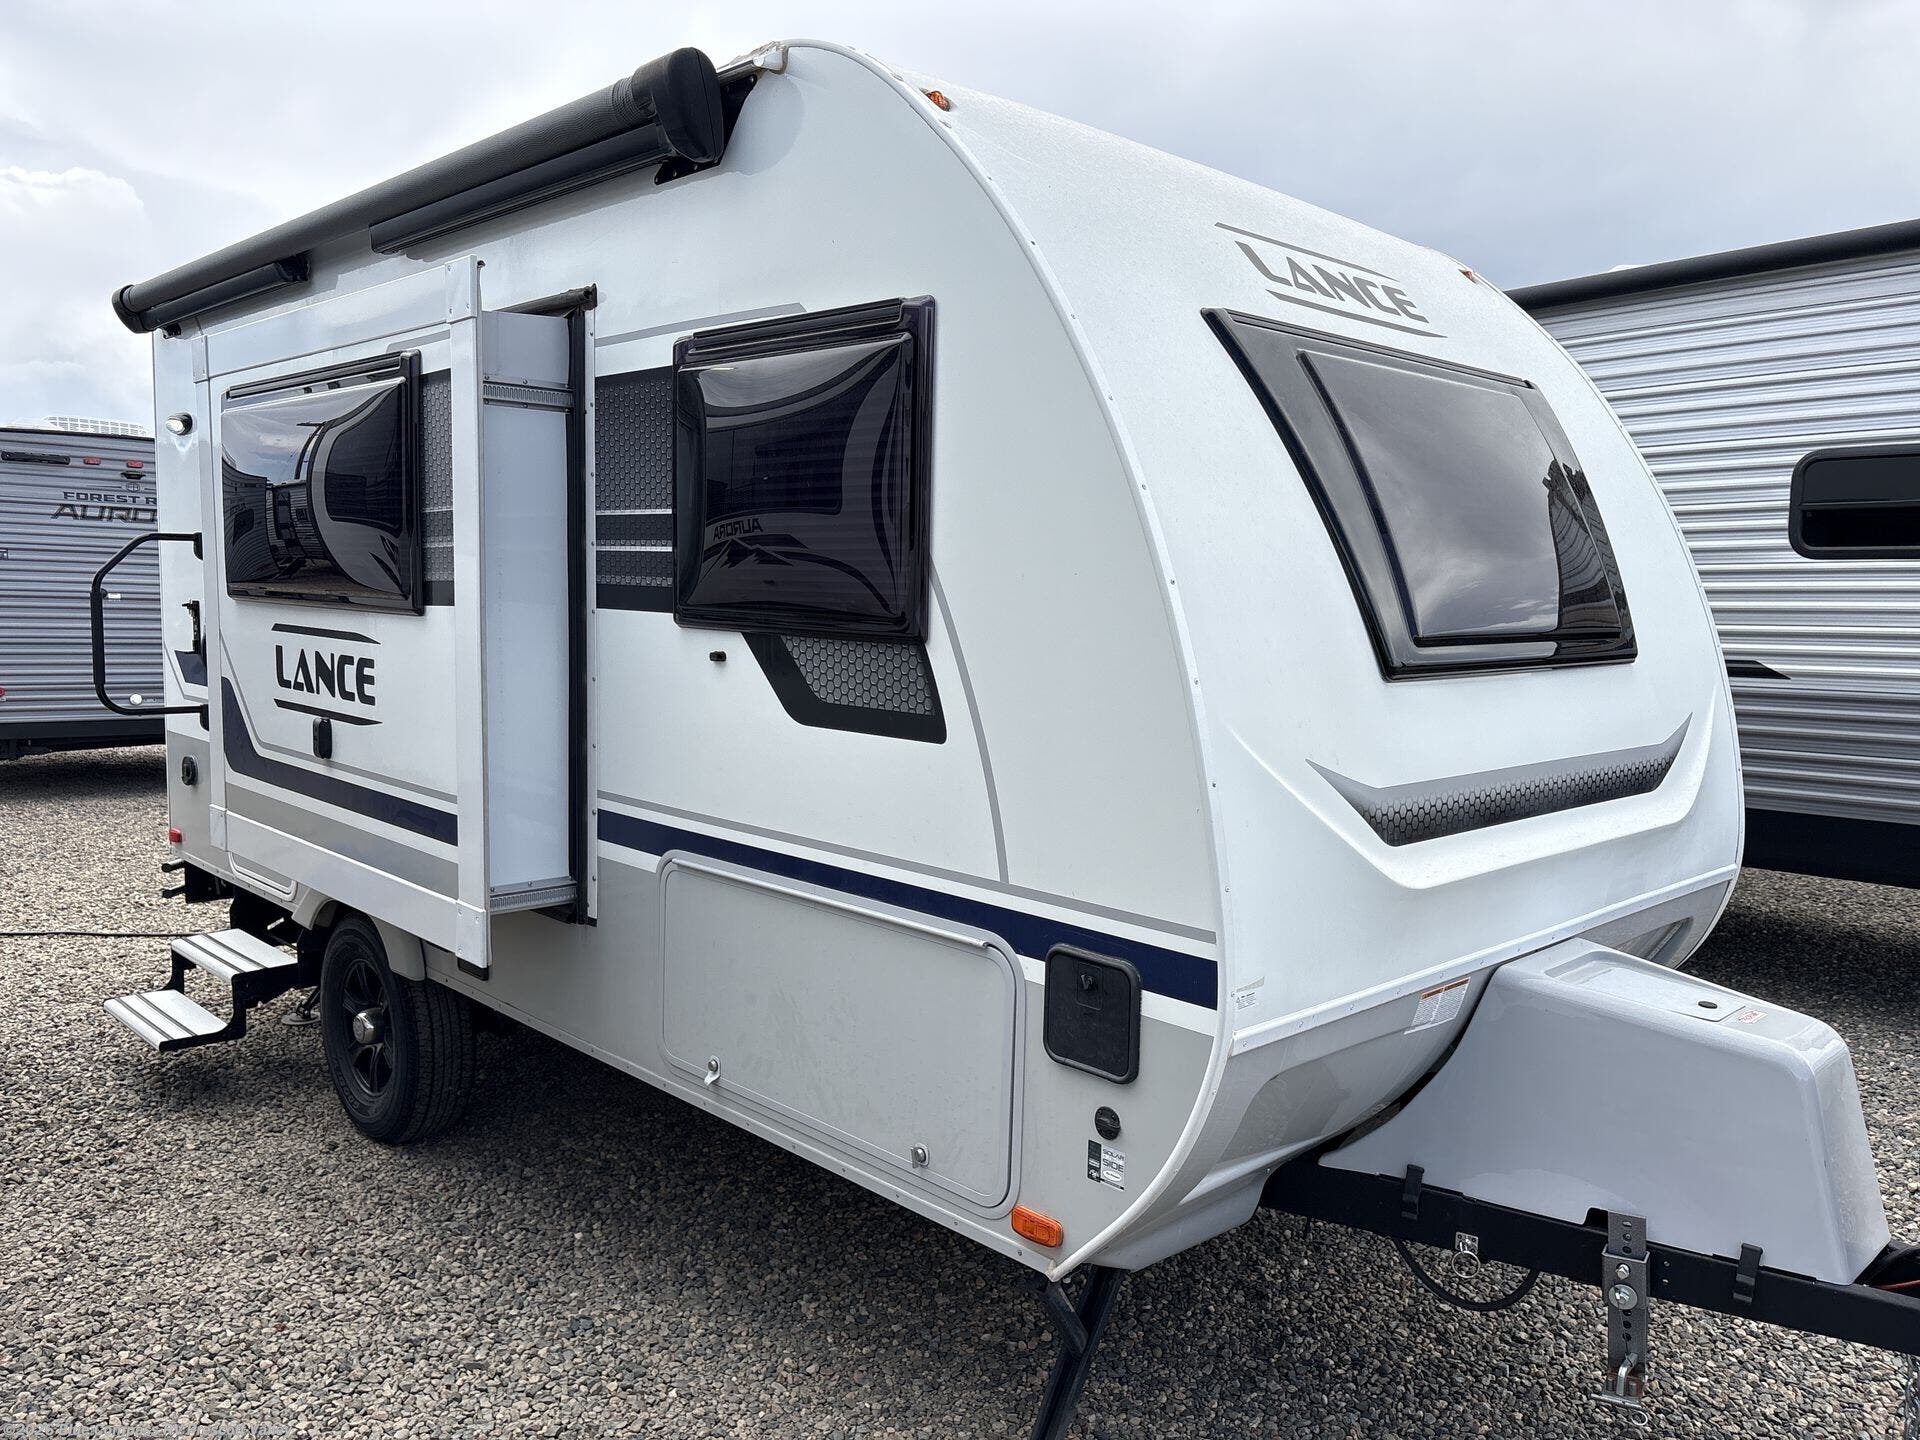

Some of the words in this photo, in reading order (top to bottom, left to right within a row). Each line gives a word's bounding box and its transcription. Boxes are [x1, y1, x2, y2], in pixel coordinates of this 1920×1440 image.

[1235, 240, 1430, 324] LANCE
[63, 491, 140, 504] FOREST
[275, 644, 376, 707] LANCE
